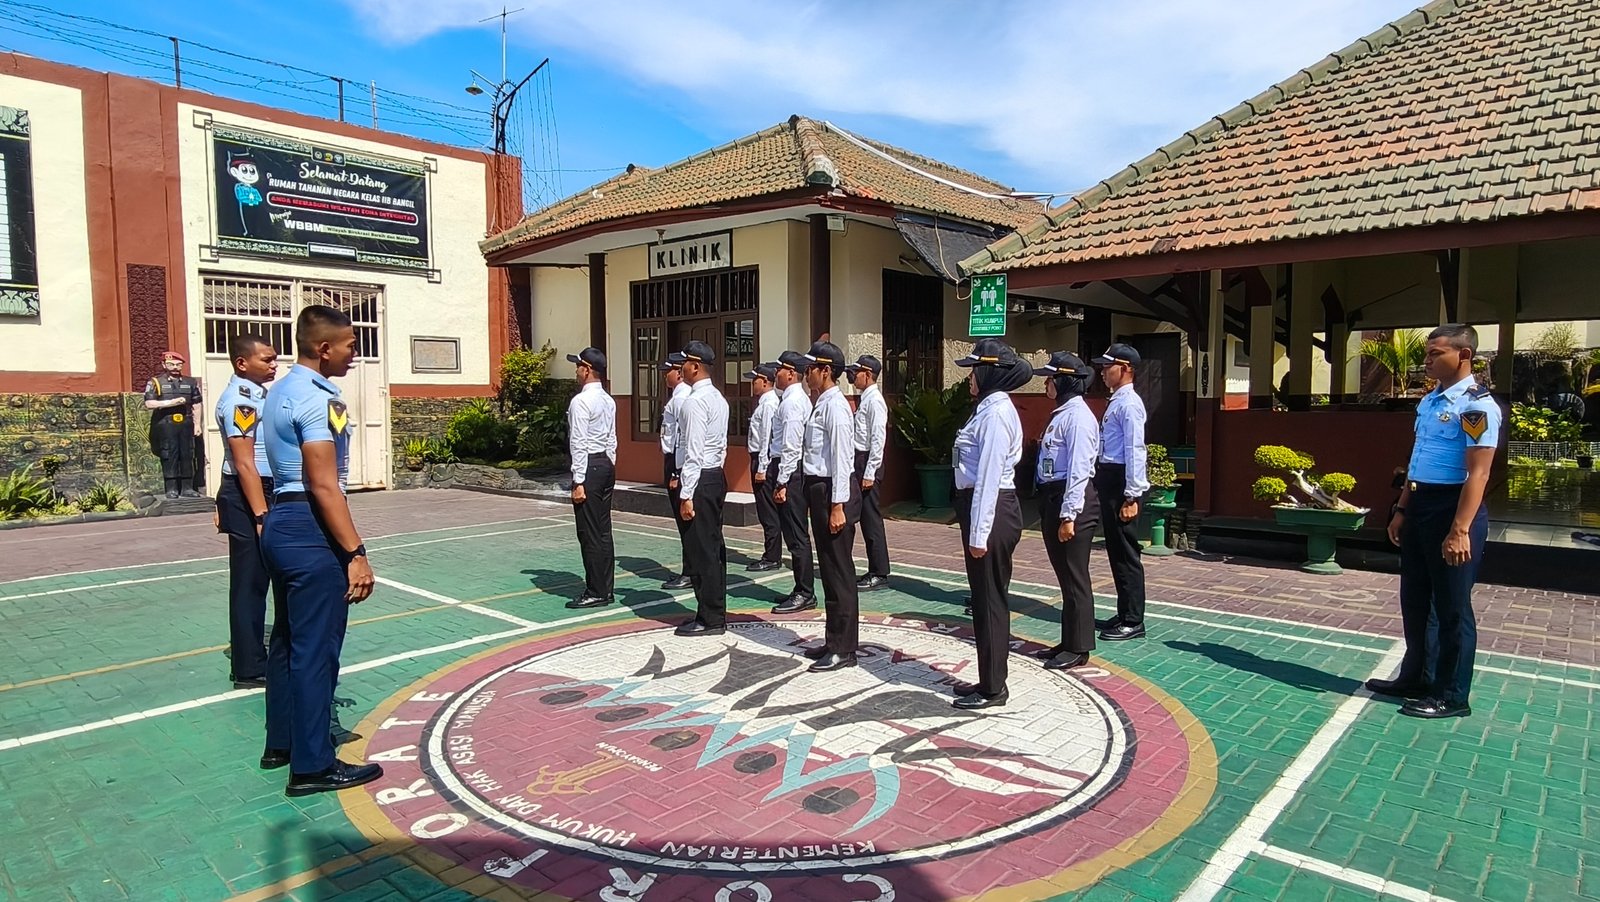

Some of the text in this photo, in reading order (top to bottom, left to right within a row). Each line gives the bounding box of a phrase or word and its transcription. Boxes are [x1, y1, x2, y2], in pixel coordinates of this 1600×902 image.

[299, 162, 389, 194] Selamat Datang
[269, 178, 415, 209] RUMAH TAHANAN NEGARA KELAS IIB BANGIL
[271, 195, 292, 204] ANDA
[330, 203, 360, 213] WILAYAH
[361, 207, 379, 217] ZONA
[283, 219, 322, 233] WBBM
[656, 242, 722, 270] KLINIK
[450, 690, 876, 860] KEMENTERIAN HUKUM DAN HAK ASASI MANUSIA
